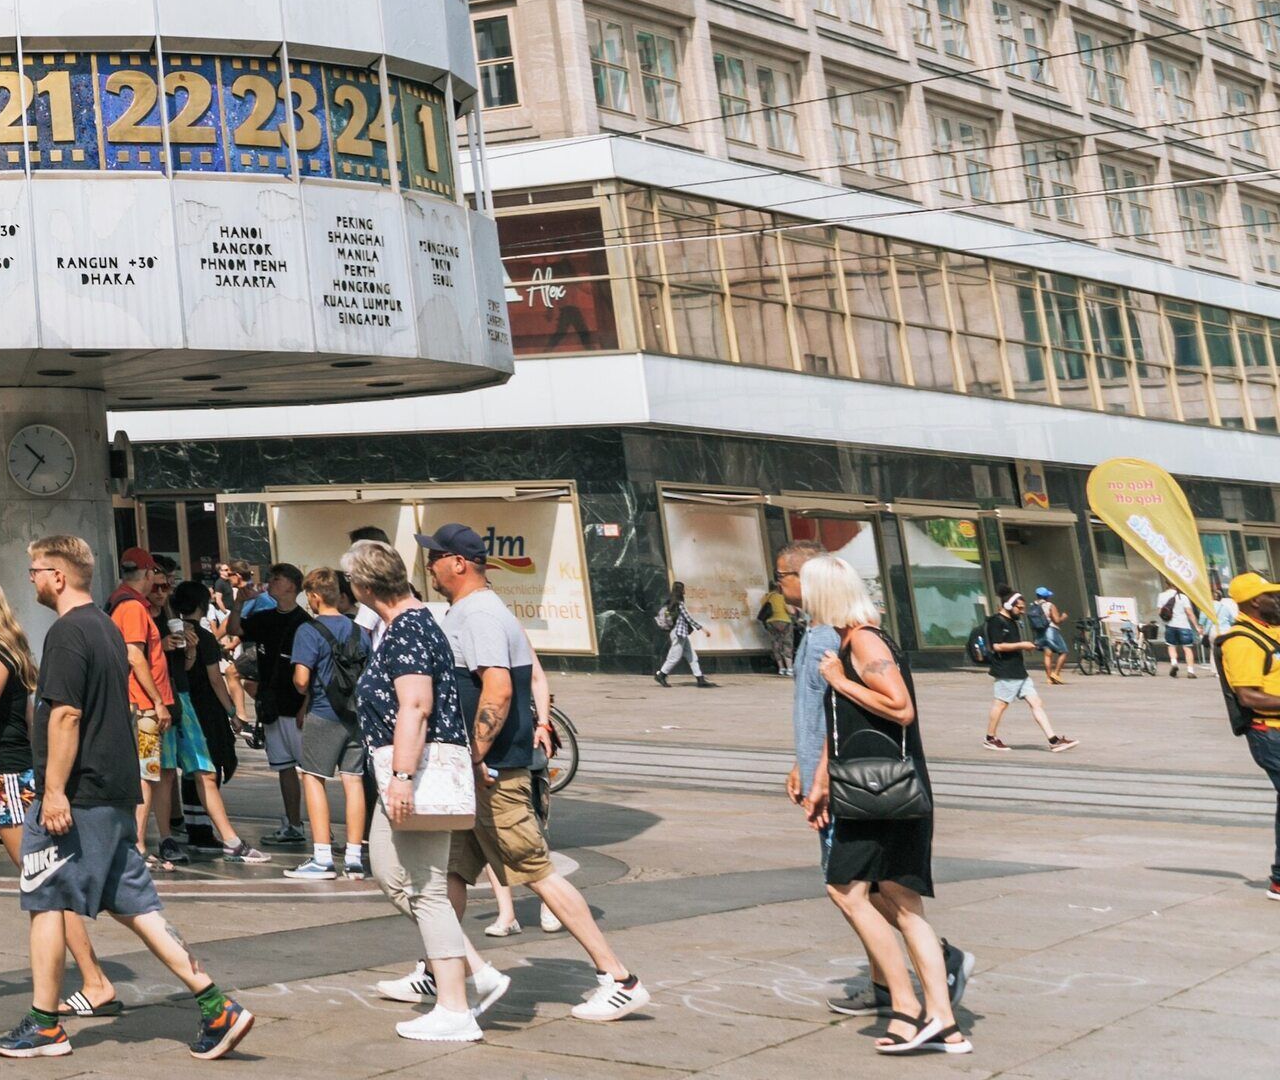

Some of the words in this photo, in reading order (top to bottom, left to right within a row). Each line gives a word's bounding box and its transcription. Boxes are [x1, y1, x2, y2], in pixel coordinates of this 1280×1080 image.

[105, 70, 216, 144] 22
[232, 74, 322, 150] 23
[334, 84, 402, 162] 24
[416, 104, 438, 172] 1
[336, 216, 373, 230] PEKING
[220, 226, 262, 239] HANOI
[328, 231, 384, 248] SHANGHAI
[212, 242, 272, 256] BANGKOK
[337, 248, 380, 263] MANILA
[57, 256, 118, 269] RANGUN
[200, 258, 247, 271] PHNOM
[254, 260, 288, 272] PENH
[431, 257, 450, 272] TOKYO
[344, 264, 376, 278] PERTH
[81, 274, 136, 285] DHAKA
[216, 274, 276, 288] JAKARTA
[432, 273, 454, 288] SEOUL
[333, 279, 390, 296] HONGKONG
[526, 267, 566, 308] Alex
[323, 294, 358, 310] KUALA
[362, 297, 403, 312] LUMPUR
[338, 312, 391, 327] SINGAPUR
[482, 526, 524, 556] dm
[506, 599, 582, 620] chönheit
[23, 845, 58, 876] NIKE
